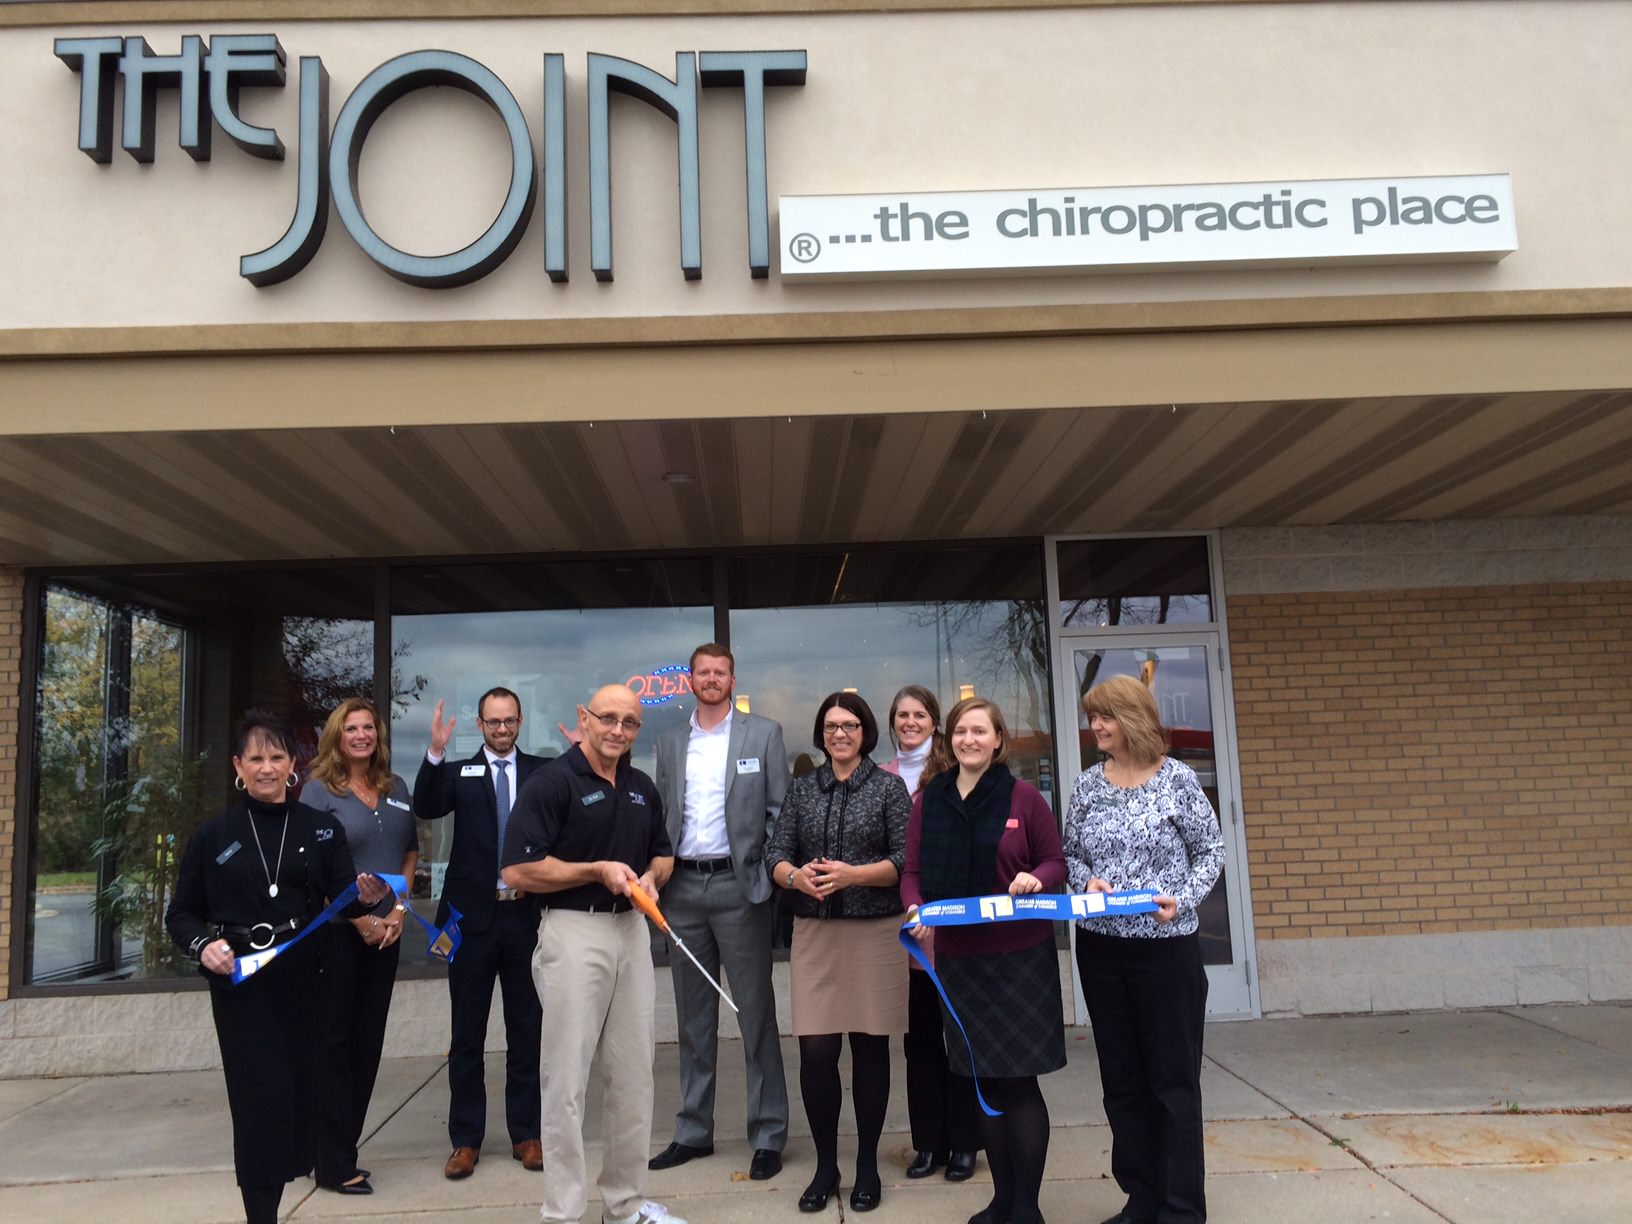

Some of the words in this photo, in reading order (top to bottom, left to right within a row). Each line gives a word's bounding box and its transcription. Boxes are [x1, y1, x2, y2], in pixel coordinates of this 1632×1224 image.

[54, 34, 286, 163] THE
[240, 49, 807, 288] JOINT
[996, 189, 1328, 241] chiropractic
[1352, 186, 1500, 234] place
